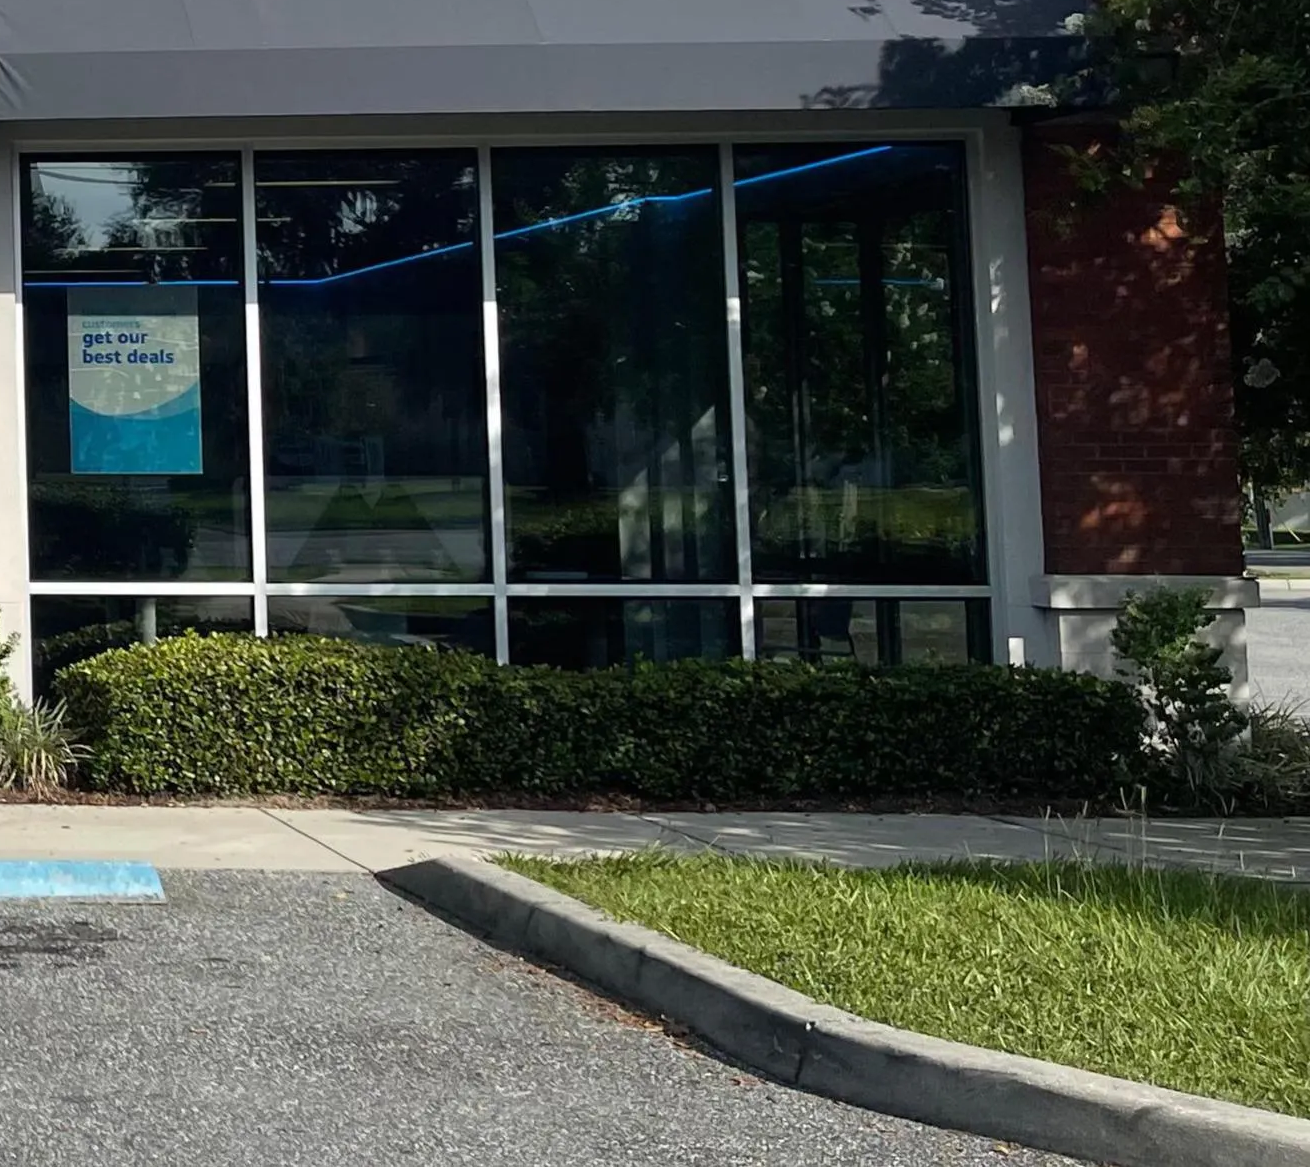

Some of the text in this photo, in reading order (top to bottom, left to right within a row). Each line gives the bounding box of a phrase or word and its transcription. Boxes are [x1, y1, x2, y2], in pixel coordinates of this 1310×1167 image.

[82, 320, 141, 329] customers
[82, 331, 149, 348] get our
[82, 349, 175, 364] best deals
